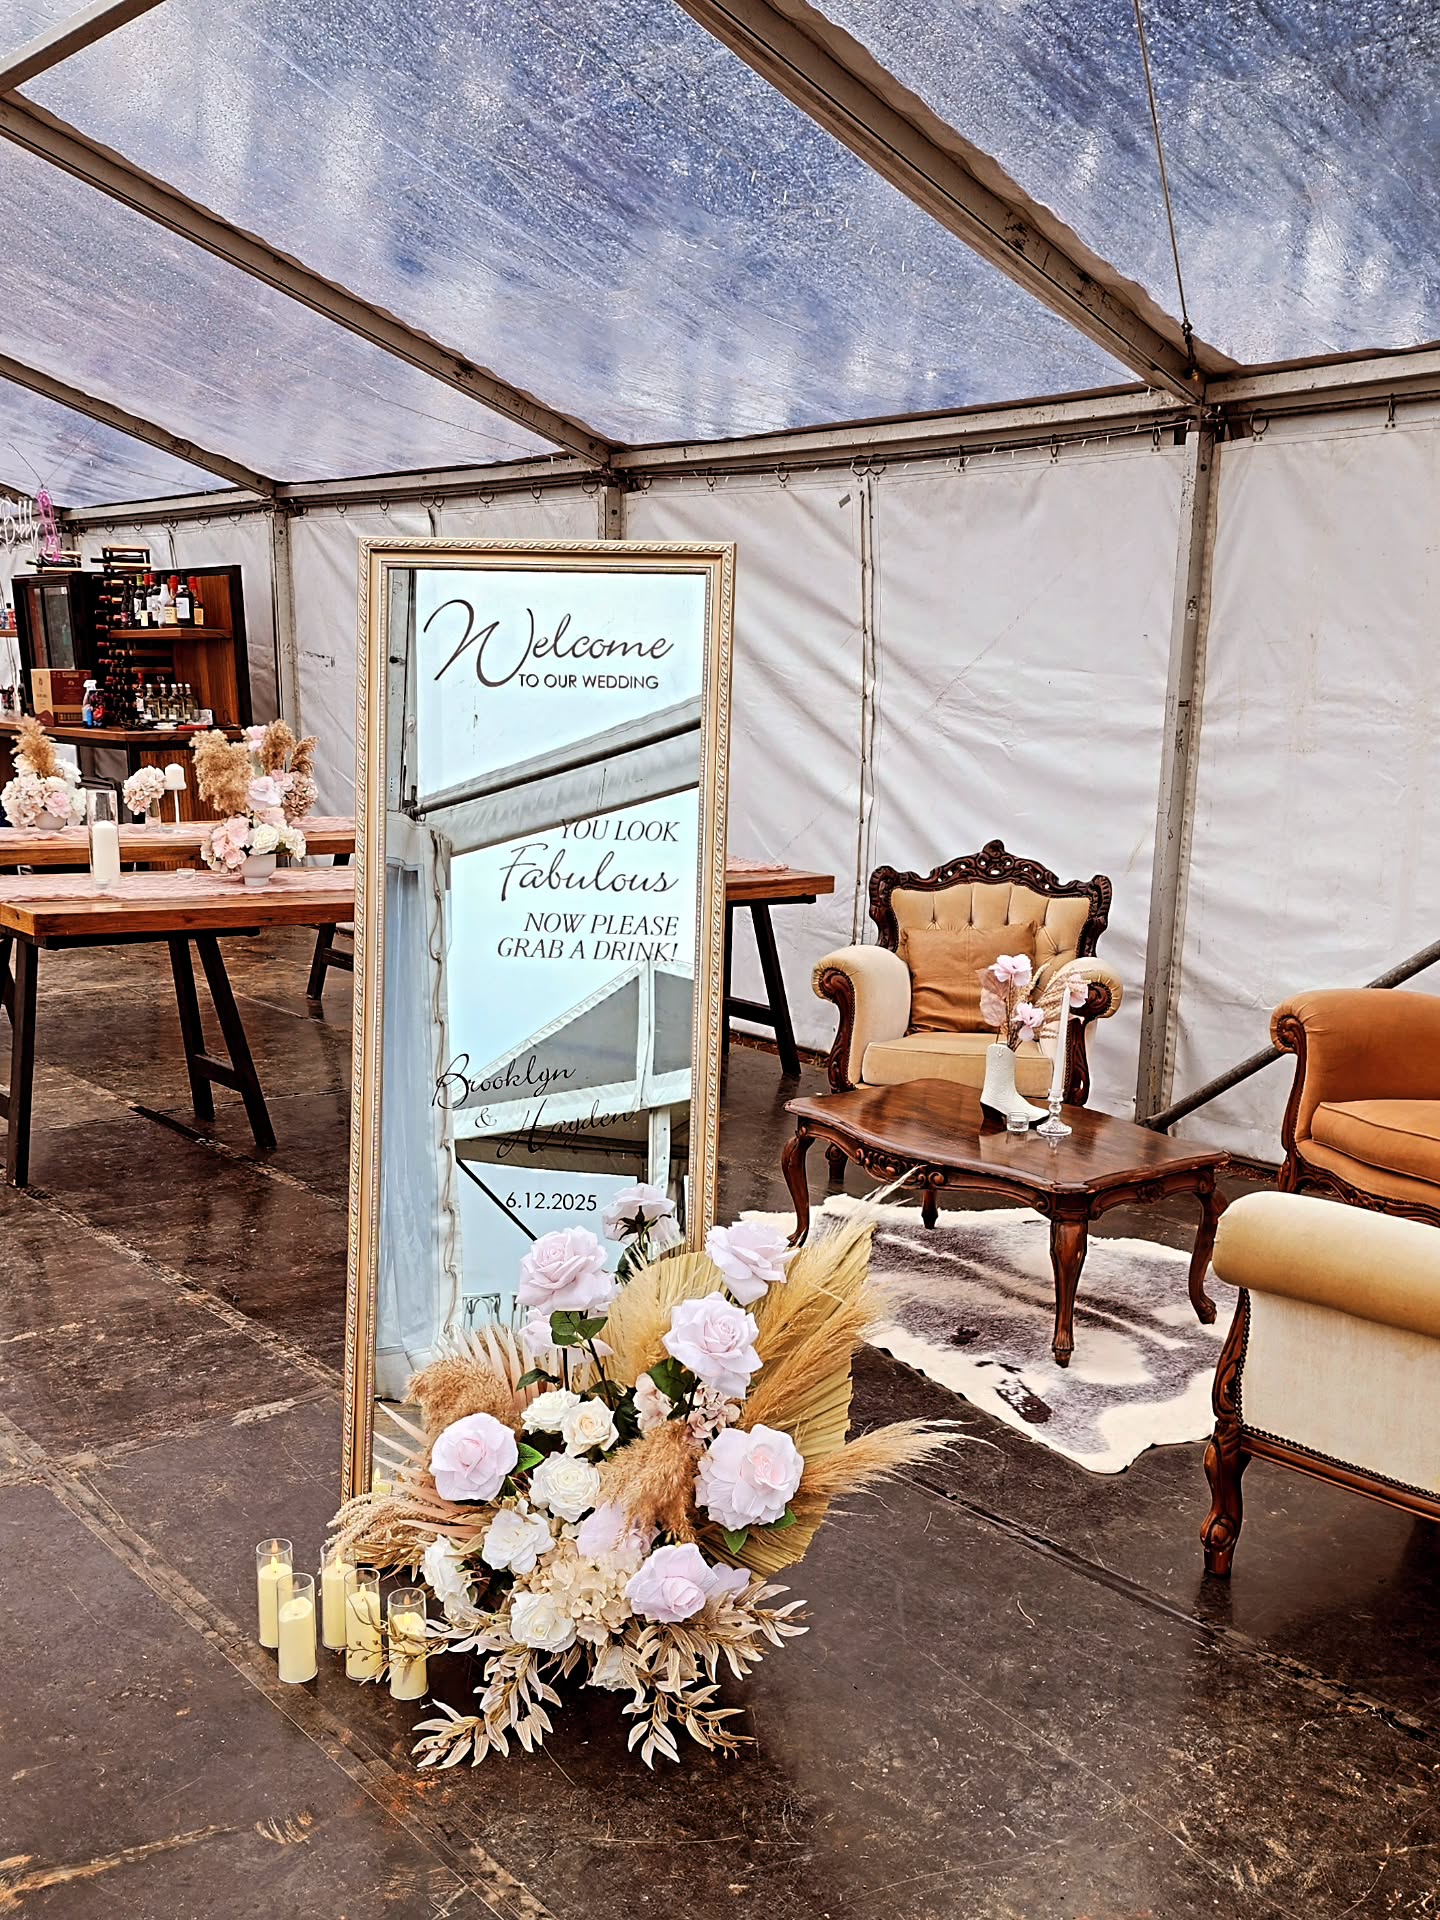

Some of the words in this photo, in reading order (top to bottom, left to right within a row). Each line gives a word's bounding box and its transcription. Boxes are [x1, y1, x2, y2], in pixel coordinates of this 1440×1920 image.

[423, 599, 674, 687] Welcome
[519, 674, 539, 687] TO
[544, 674, 577, 688] OUR
[582, 675, 659, 689] WEDDING
[561, 818, 609, 841] YOU
[614, 820, 680, 842] LOOK
[499, 842, 679, 901] Fabulous
[524, 912, 586, 933] NOW
[590, 914, 679, 936] PLEASE
[497, 937, 563, 959] GRAB
[568, 940, 587, 960] A
[593, 941, 678, 962] DRINK!
[431, 1053, 576, 1110] Brooklyn
[474, 1107, 498, 1128] &
[495, 1098, 640, 1158] Hayden
[505, 1192, 597, 1211] 6.12.2025
